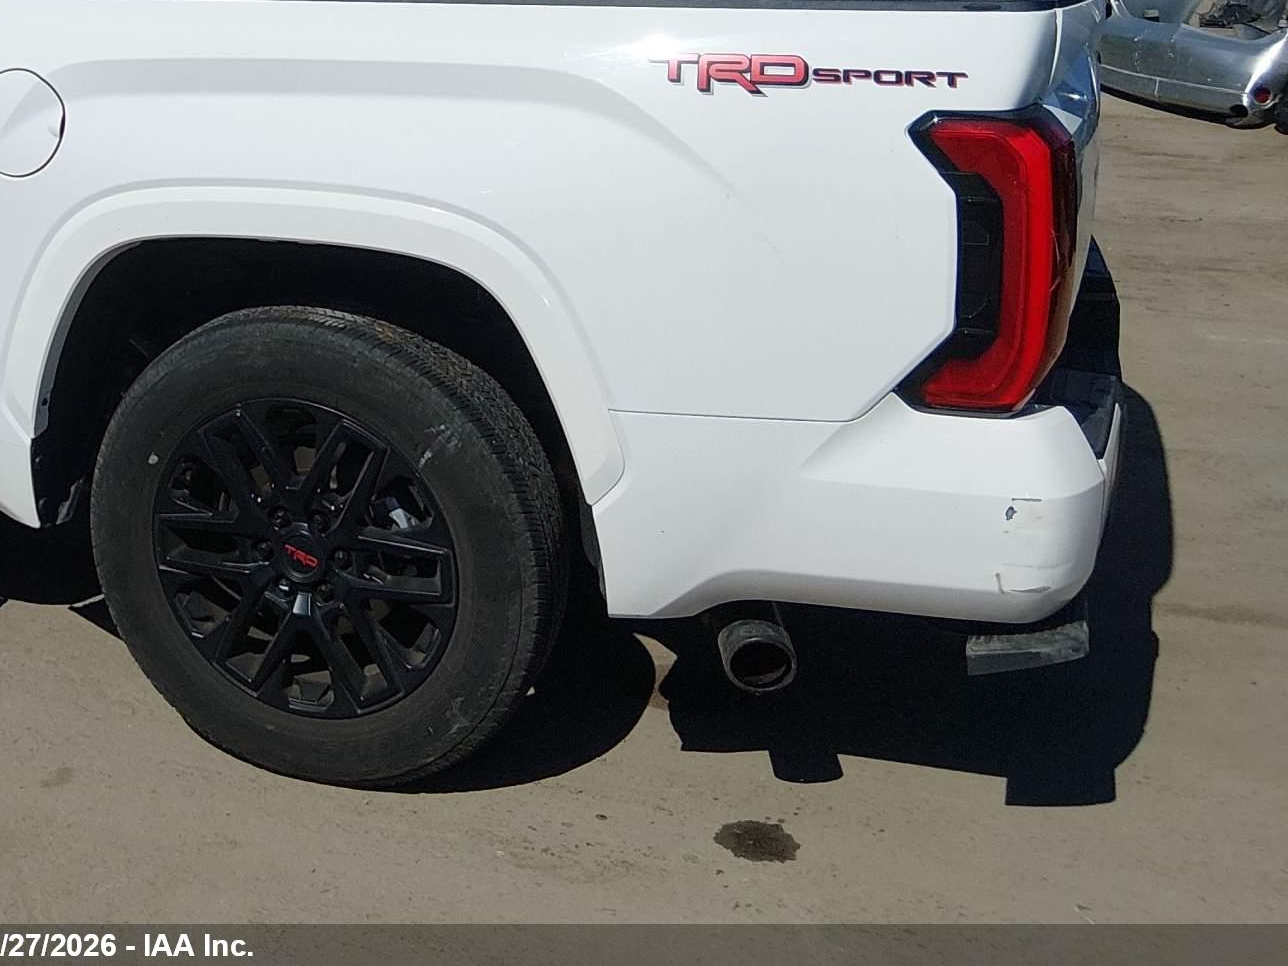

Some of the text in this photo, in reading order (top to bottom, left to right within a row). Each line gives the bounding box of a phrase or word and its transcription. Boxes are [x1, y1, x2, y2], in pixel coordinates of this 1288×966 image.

[648, 52, 968, 98] TRD SPORT
[283, 543, 319, 568] TRD
